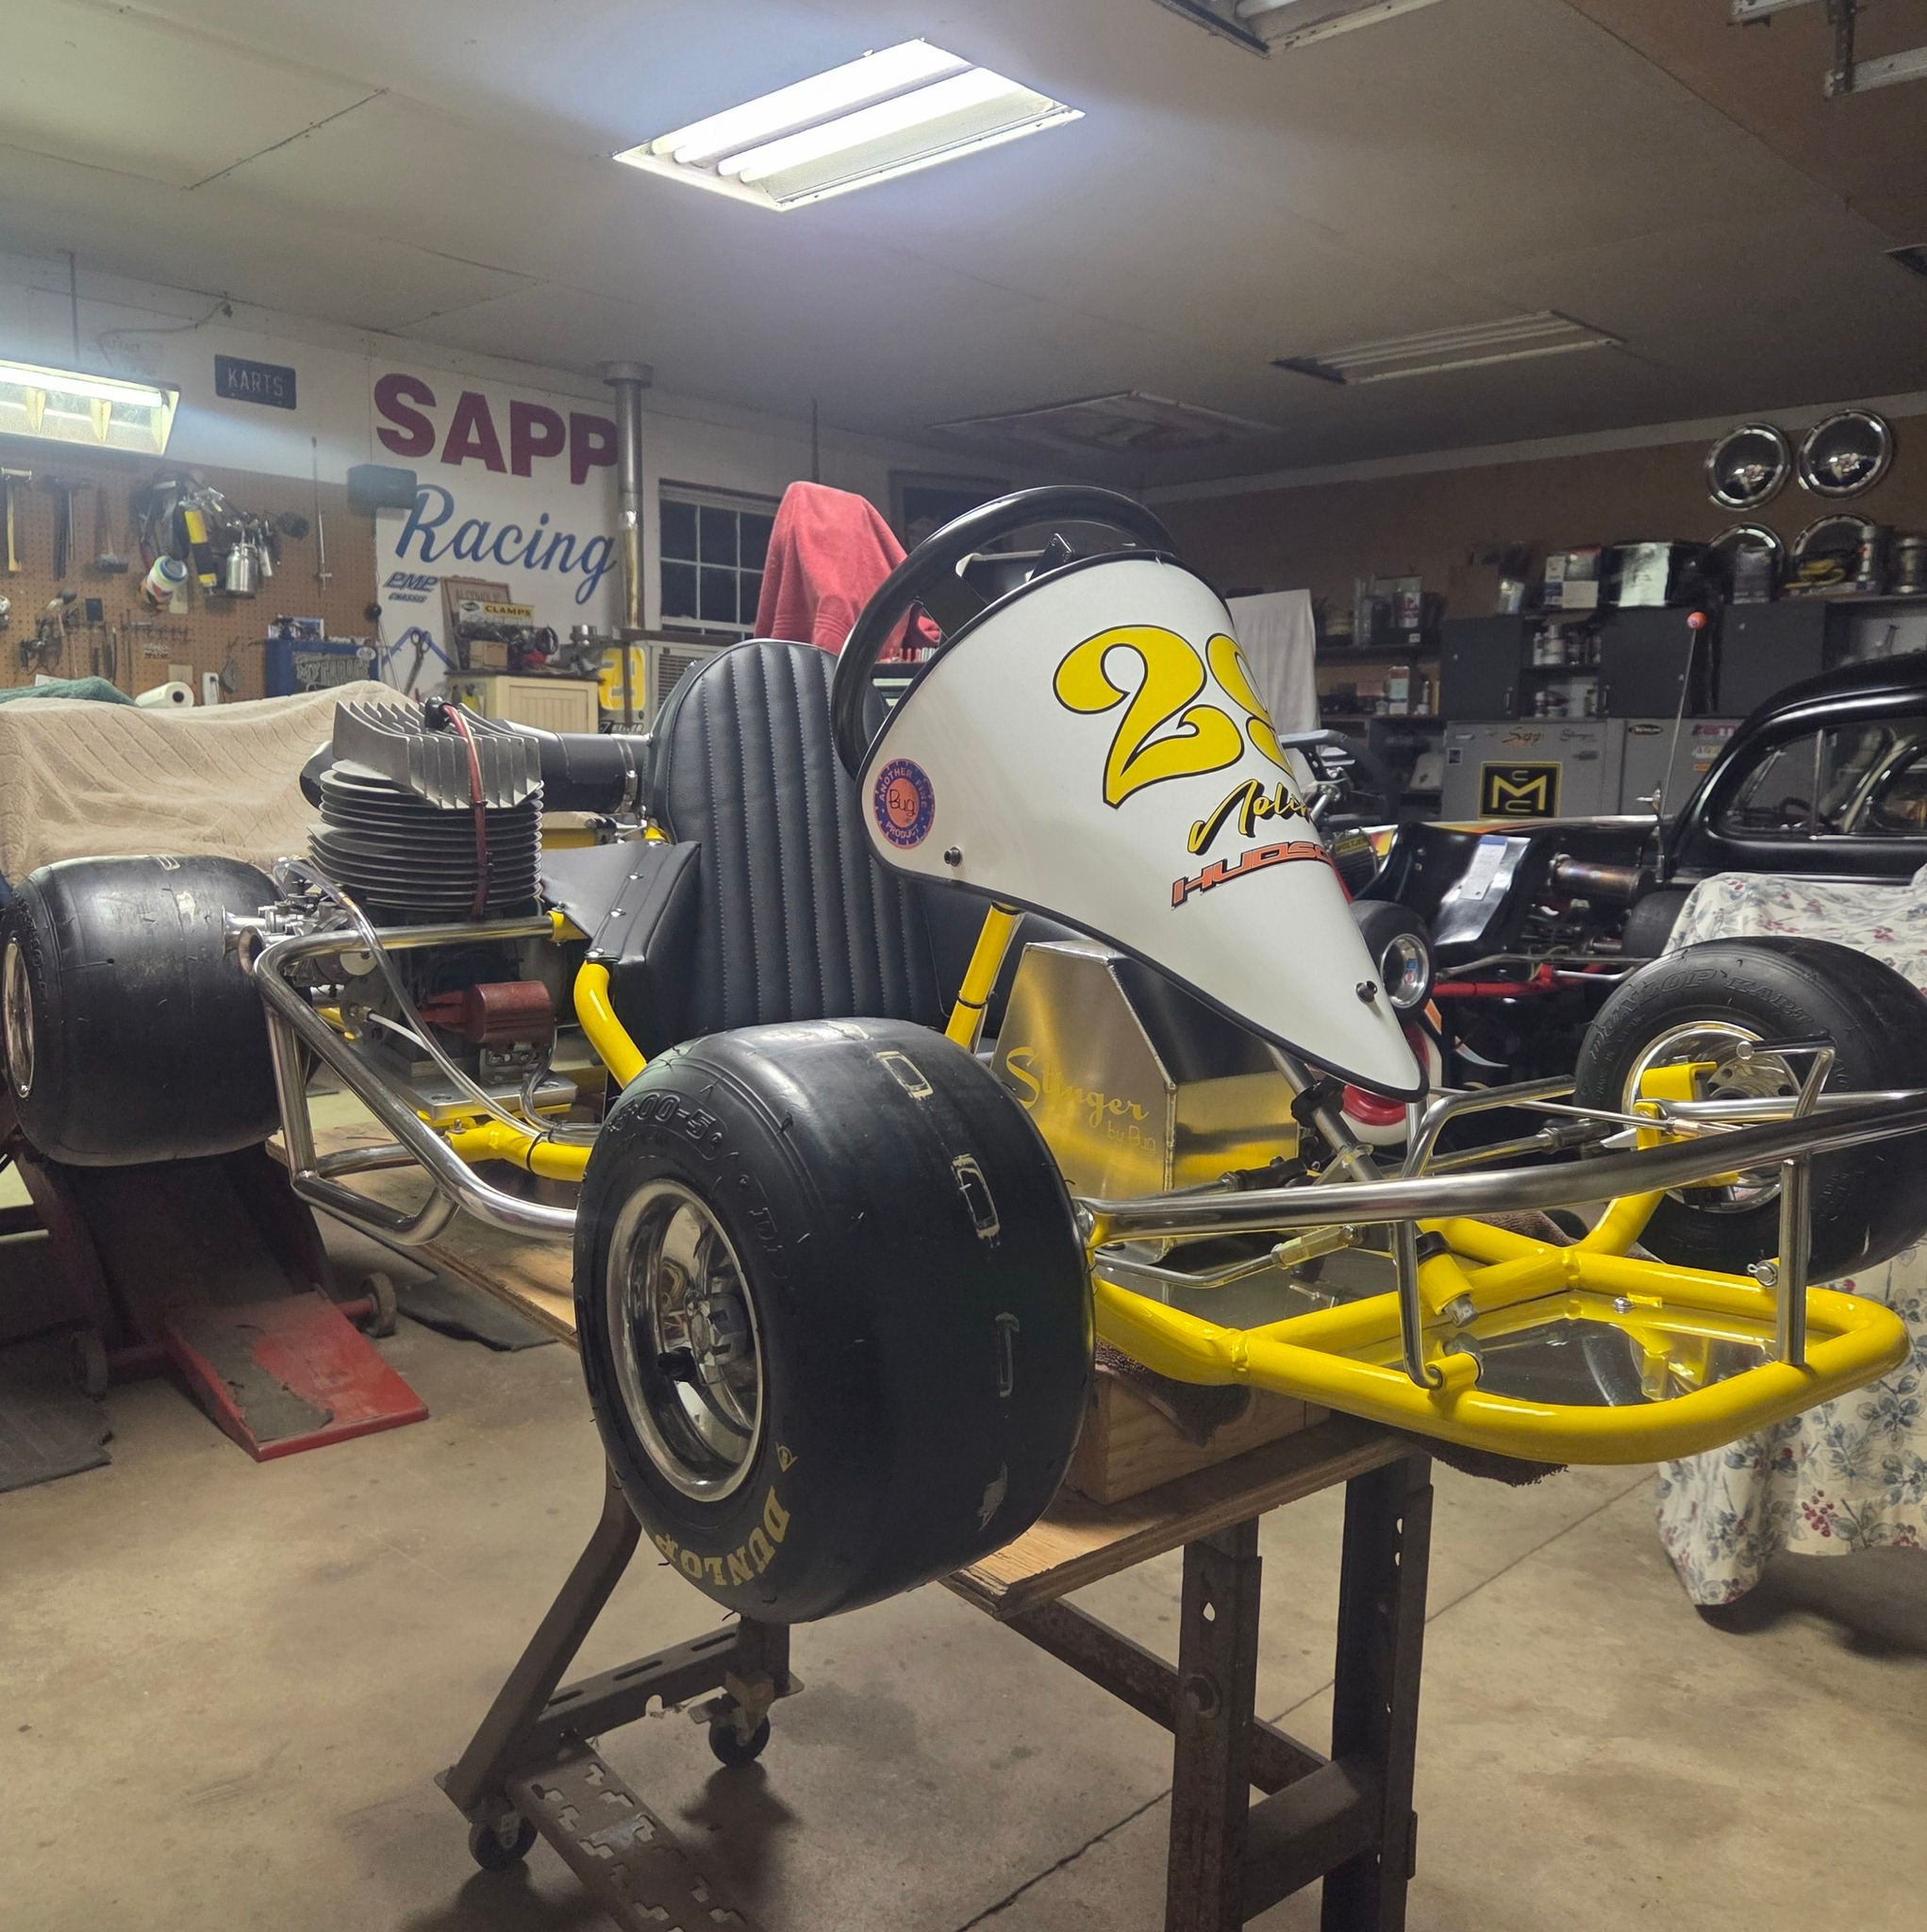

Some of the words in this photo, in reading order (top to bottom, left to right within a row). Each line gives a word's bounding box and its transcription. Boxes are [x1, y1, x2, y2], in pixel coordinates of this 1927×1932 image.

[227, 366, 284, 398] KARTS
[374, 373, 619, 486] SAPP
[394, 483, 618, 606] Racing
[485, 605, 532, 617] CLAMPS
[878, 767, 913, 802] ANOTHER
[889, 789, 917, 818] Bug
[1005, 1045, 1150, 1128] Stinger
[655, 1485, 791, 1587] DUNLOP
